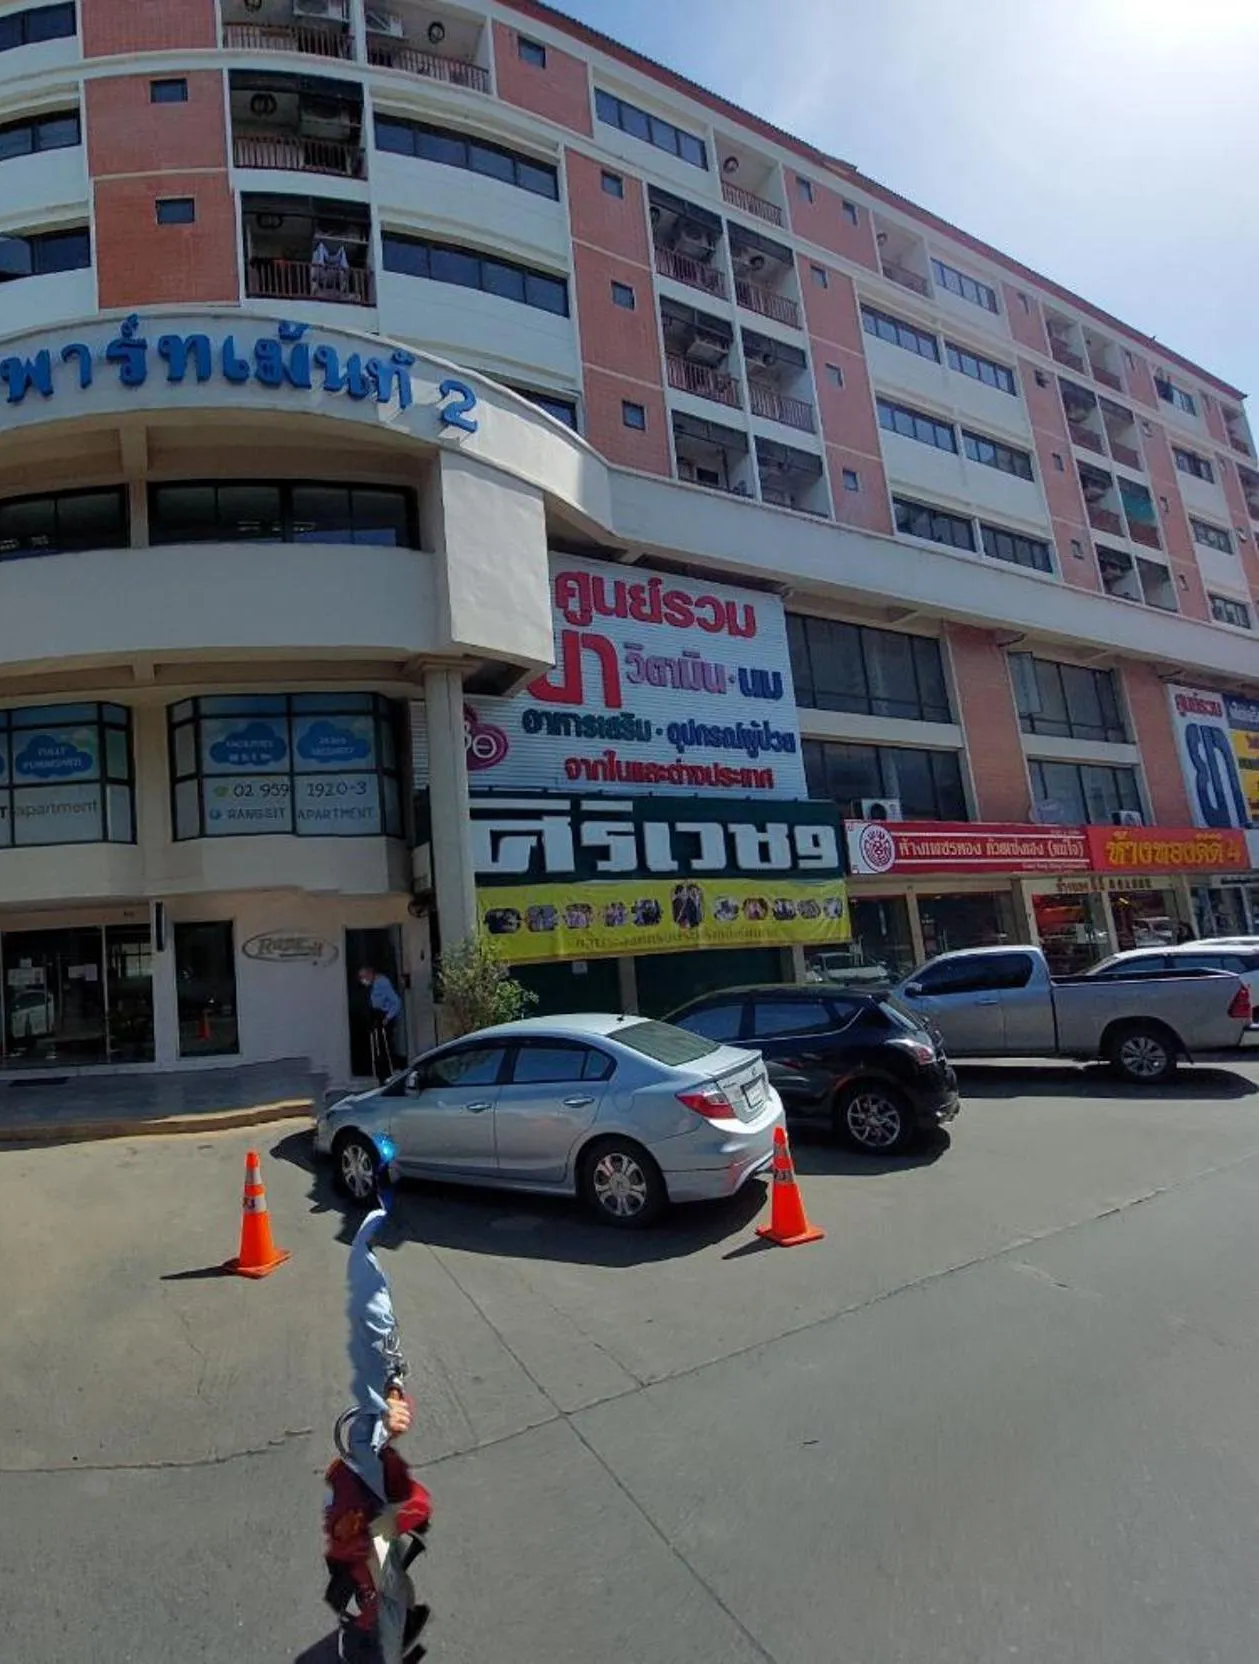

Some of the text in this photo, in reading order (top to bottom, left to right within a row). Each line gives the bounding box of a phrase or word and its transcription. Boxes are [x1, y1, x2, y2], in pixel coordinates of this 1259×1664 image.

[439, 379, 479, 434] 2
[554, 570, 757, 638] ศูนย์รวม
[623, 642, 784, 701] วิตามิน นม
[521, 708, 652, 742] อาหารเสริม
[233, 783, 255, 798] 02
[564, 749, 775, 788] จากในและต่างประเทศ
[1185, 723, 1249, 828] ยา
